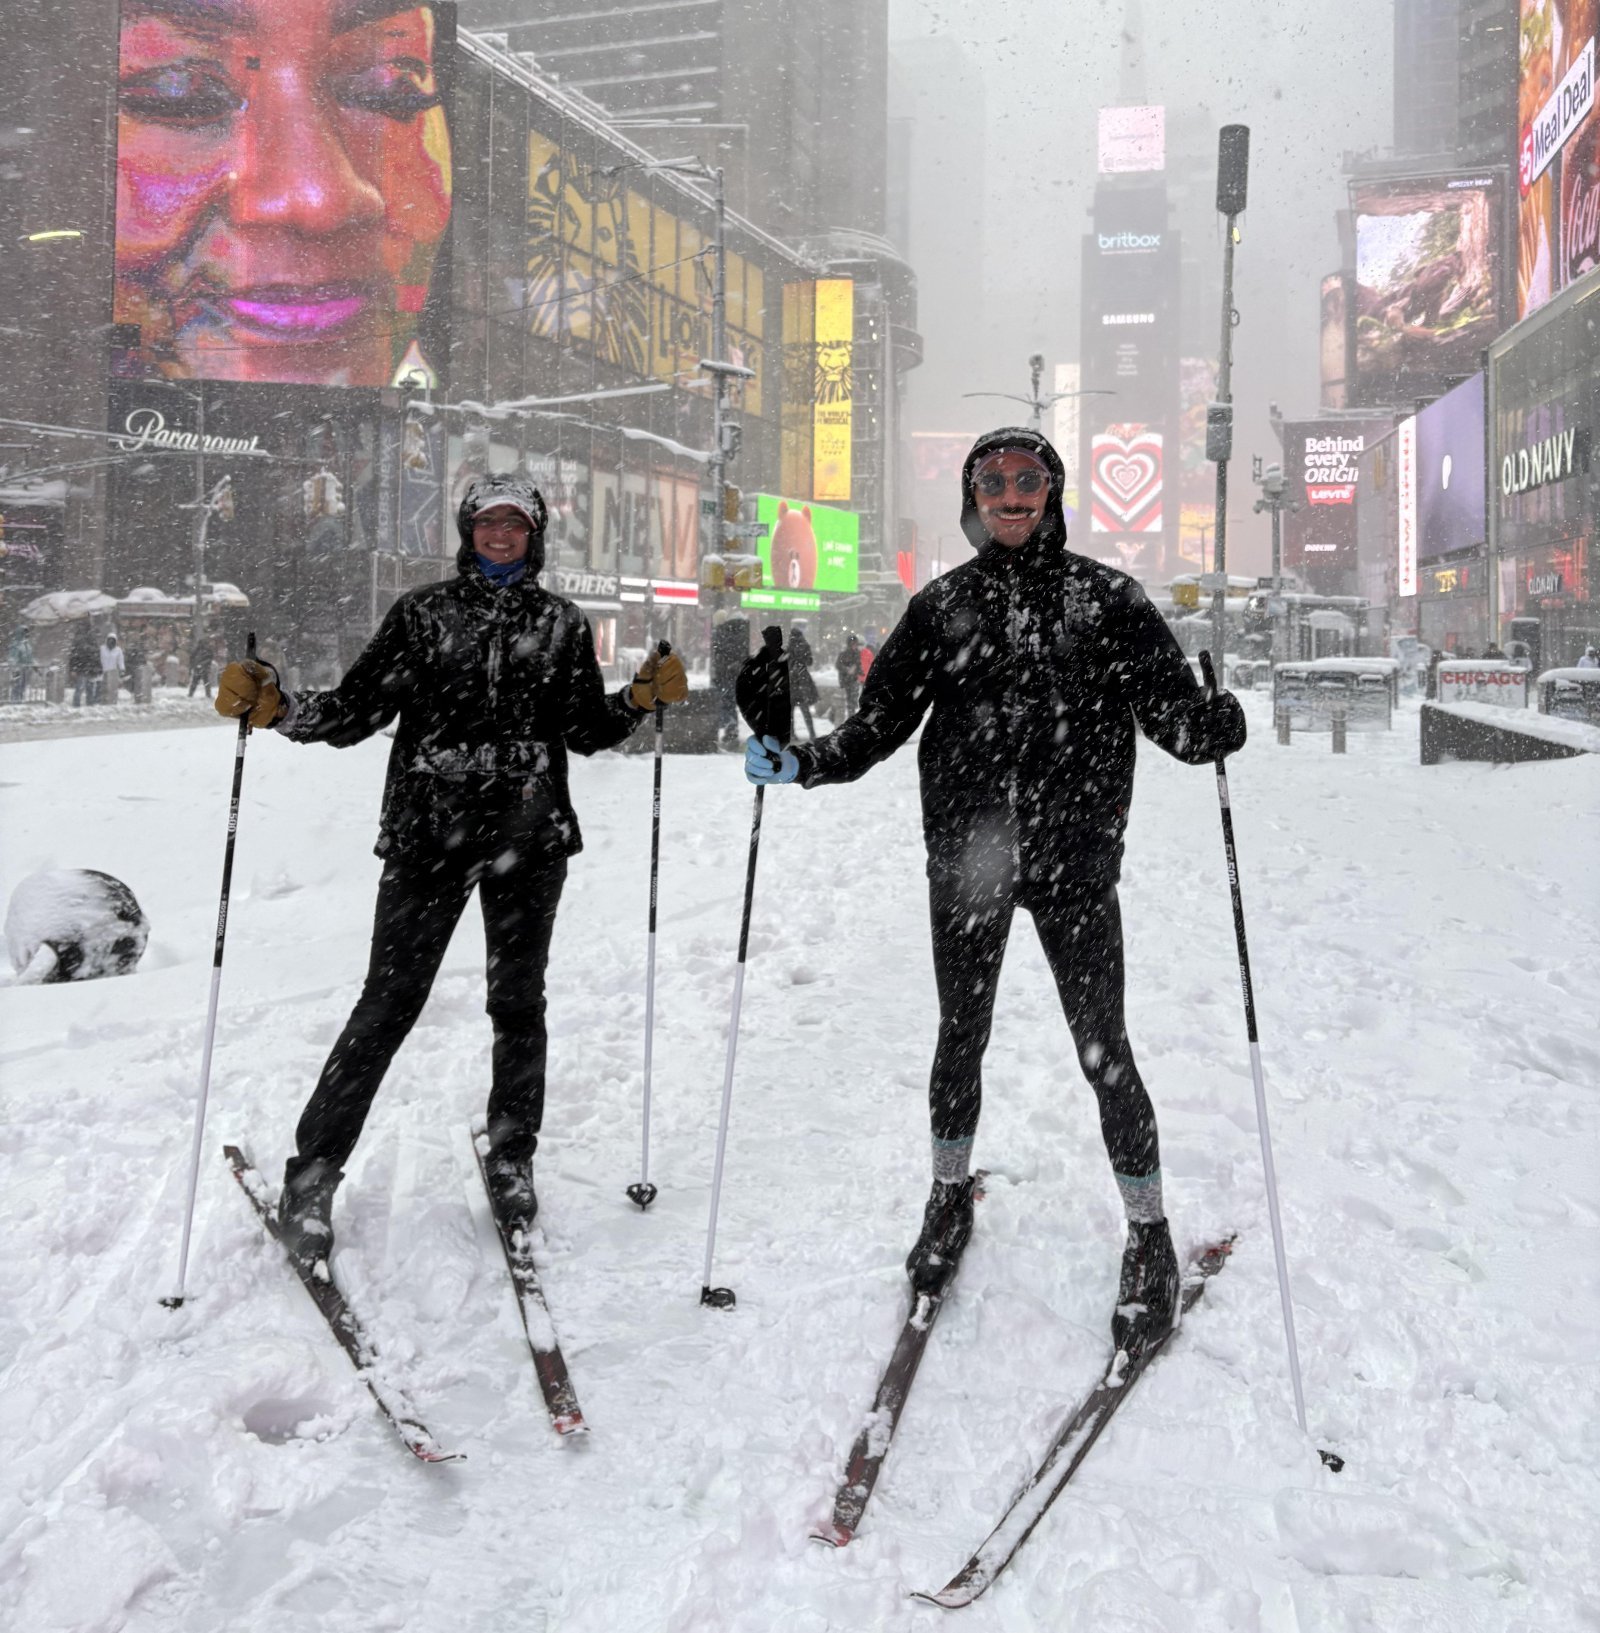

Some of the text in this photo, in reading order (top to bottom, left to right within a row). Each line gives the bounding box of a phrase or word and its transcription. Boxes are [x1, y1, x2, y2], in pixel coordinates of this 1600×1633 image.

[1534, 95, 1561, 168] Meal
[1563, 52, 1591, 124] Deal
[1098, 232, 1160, 249] britbox
[1102, 313, 1155, 325] SAMSUNG
[118, 408, 264, 454] Paramount
[1305, 436, 1364, 453] Behind
[1304, 453, 1350, 470] every
[1502, 427, 1576, 496] OLD NAVY
[1529, 573, 1559, 595] OLD NAVY
[1442, 671, 1525, 686] CHICAGO
[227, 813, 238, 833] 500
[1228, 862, 1237, 886] 500
